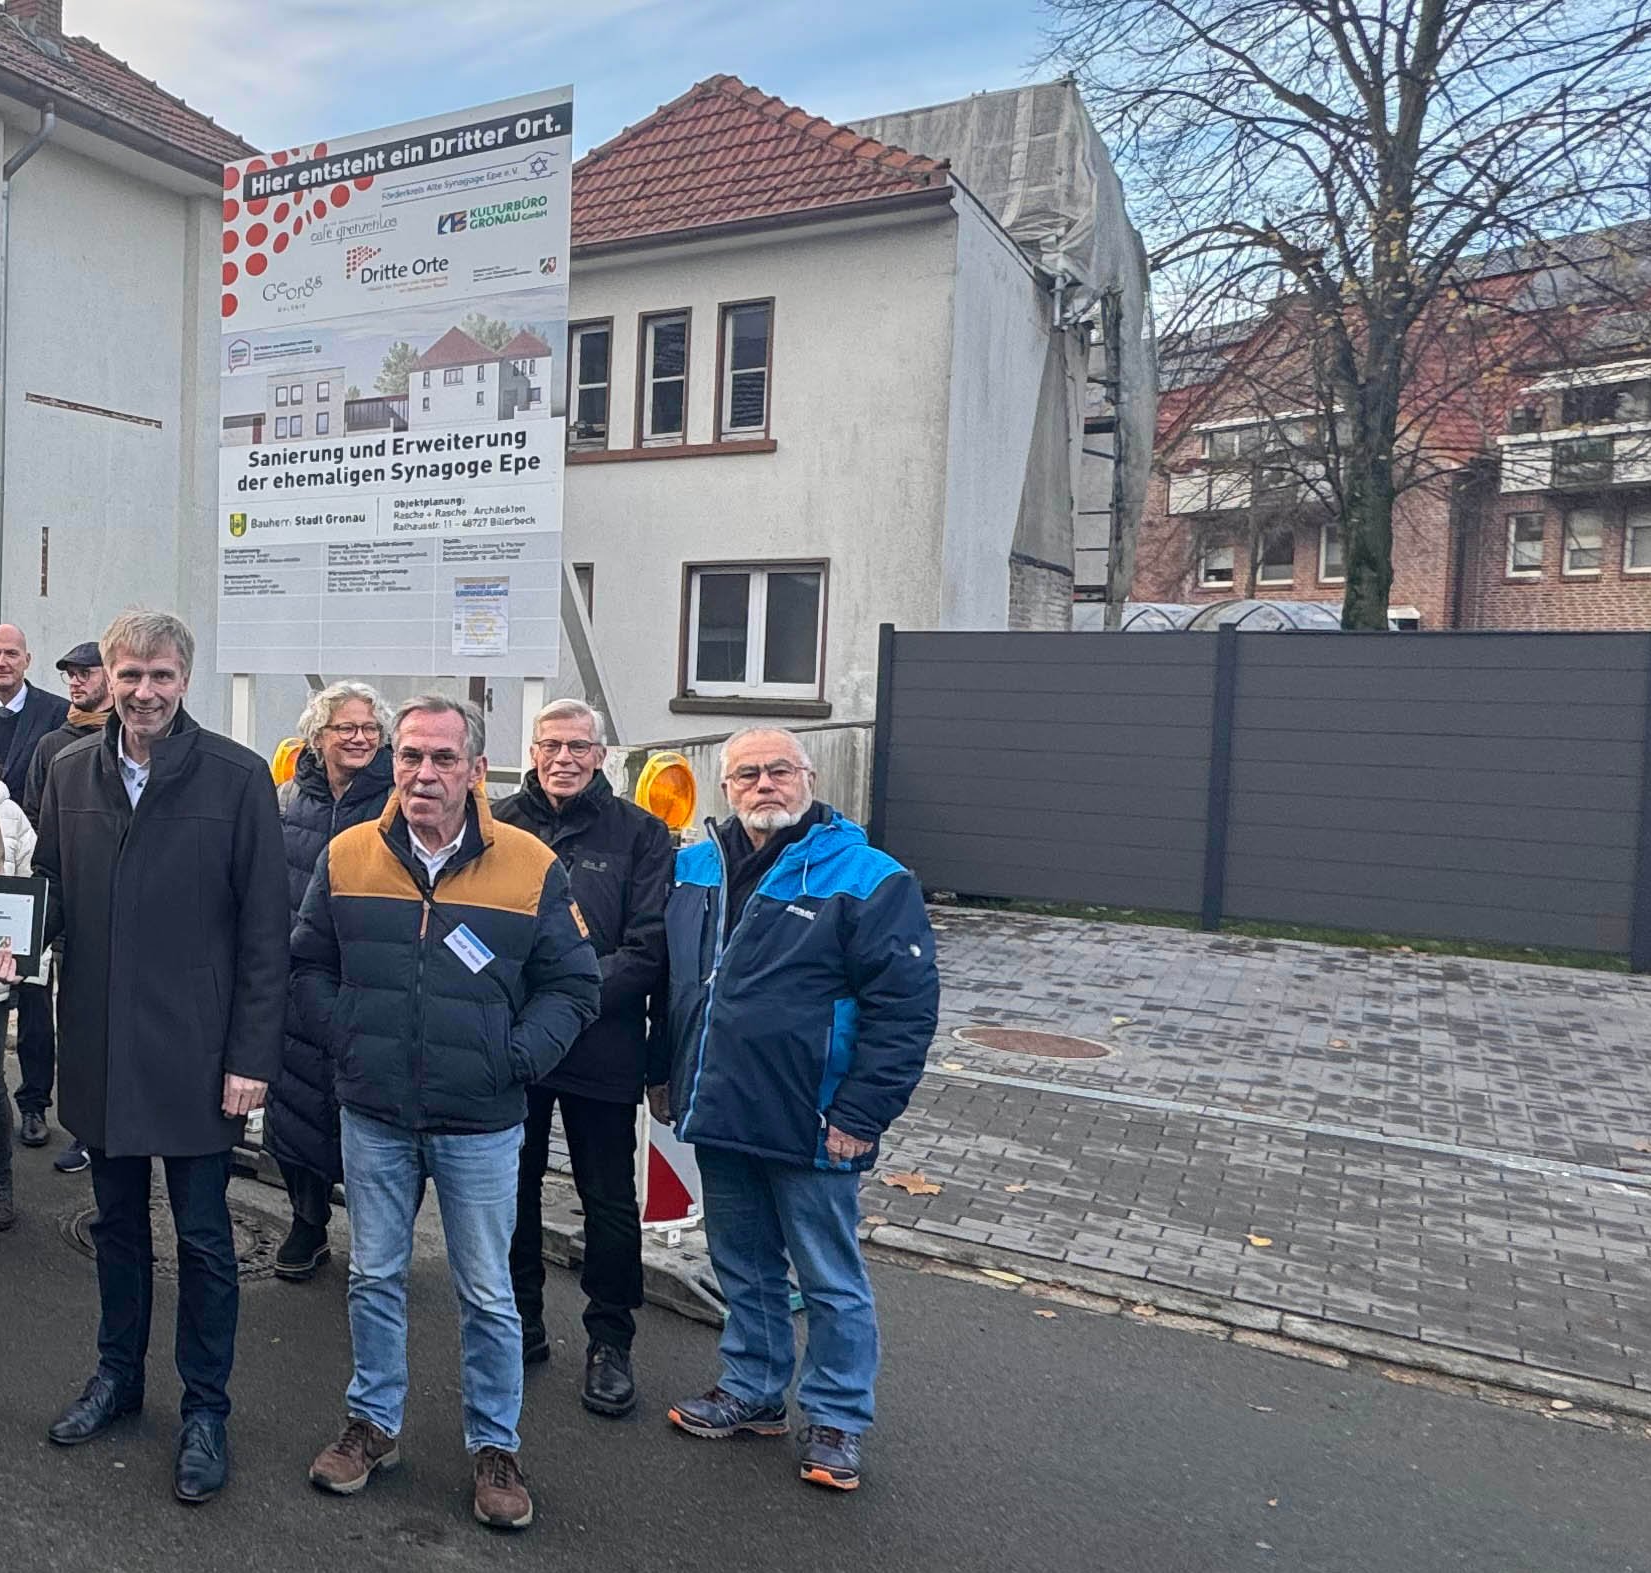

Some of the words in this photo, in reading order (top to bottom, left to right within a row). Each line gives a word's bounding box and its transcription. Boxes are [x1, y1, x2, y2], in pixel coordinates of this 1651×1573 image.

[251, 173, 293, 196] Hier
[298, 150, 385, 186] entsteht
[390, 143, 423, 167] ein
[430, 126, 509, 159] Dritter
[515, 113, 561, 139] Ort.
[469, 195, 548, 218] KULTURBÜRO
[469, 212, 520, 230] GRONAU
[361, 263, 408, 284] Dritte
[412, 257, 449, 276] Orte
[248, 446, 344, 468] Sanierung
[349, 440, 386, 459] und
[392, 430, 527, 456] Erweiterung
[237, 475, 268, 491] der
[273, 467, 385, 488] ehemaligen
[391, 459, 493, 483] Synagoge
[499, 453, 541, 475] Epe
[393, 496, 466, 509] Objektplanung:
[295, 514, 323, 526] Stadt
[325, 513, 366, 524] Gronau
[393, 509, 425, 520] Rasche
[435, 507, 467, 518] Rasche
[462, 517, 488, 529] 48727
[490, 515, 536, 527] Billerbeck
